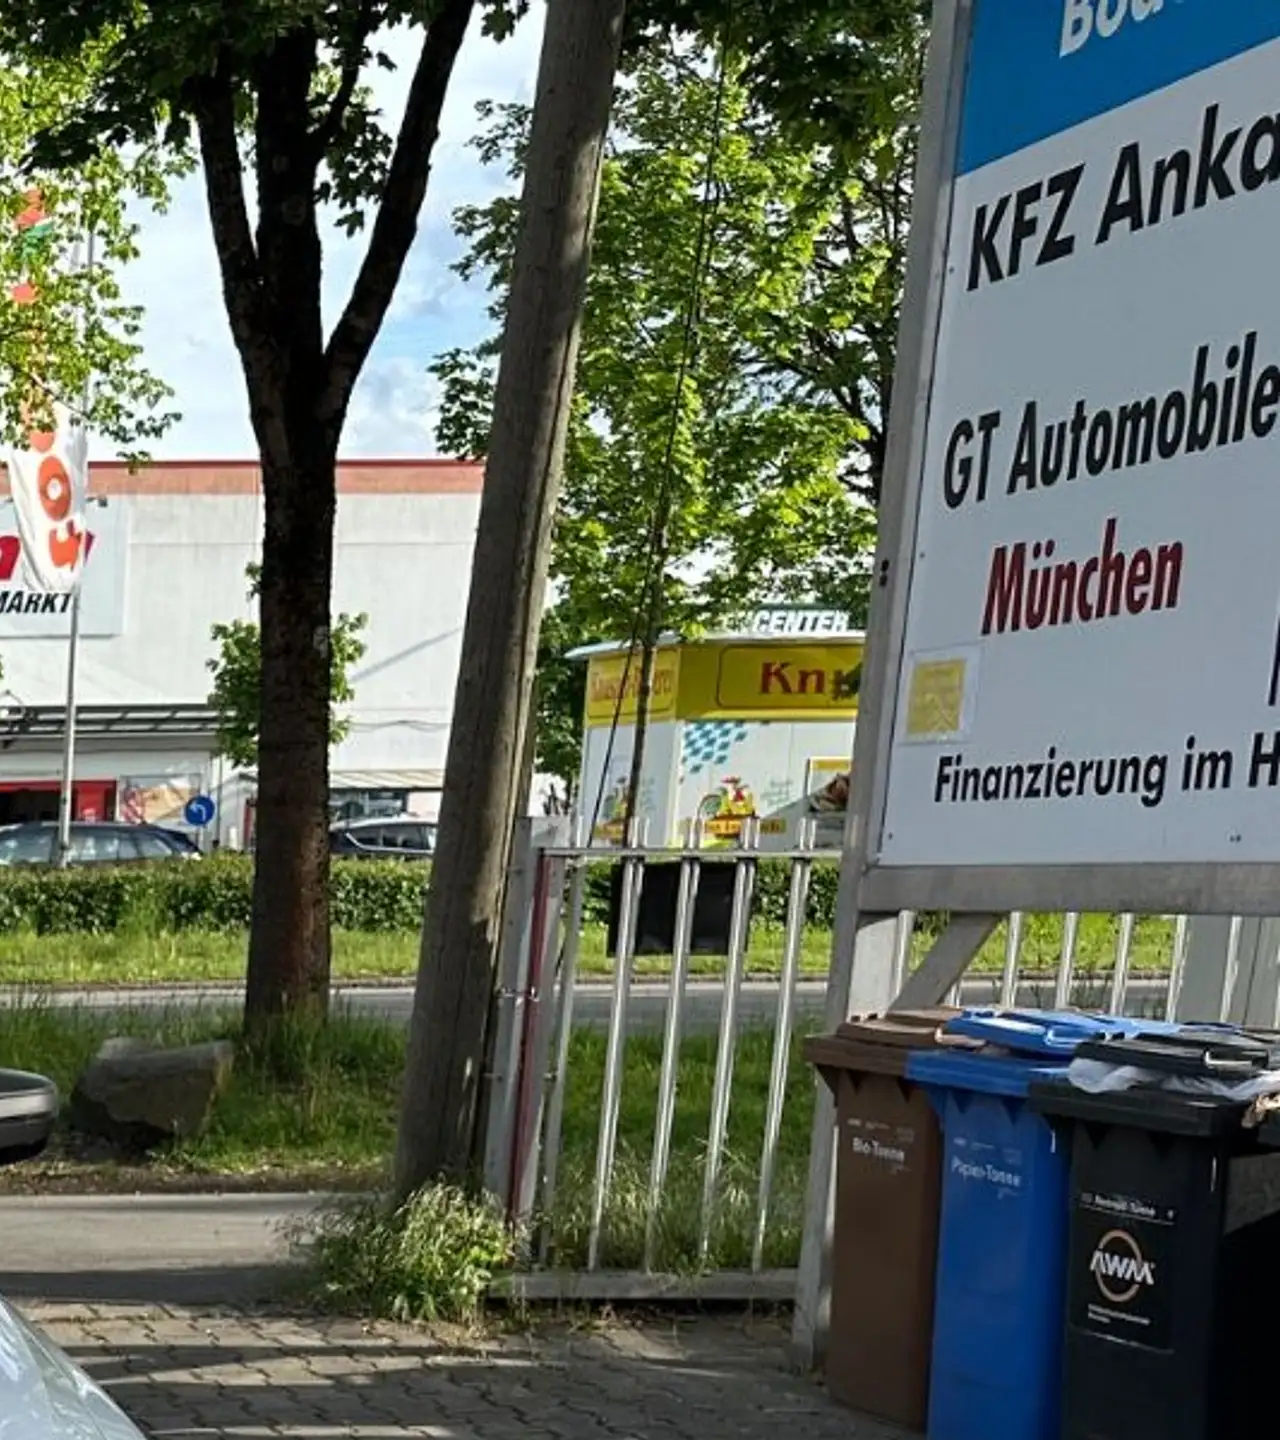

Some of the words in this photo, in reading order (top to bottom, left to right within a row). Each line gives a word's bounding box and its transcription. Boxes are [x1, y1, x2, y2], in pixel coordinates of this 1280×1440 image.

[966, 163, 1086, 292] KFZ
[943, 411, 1001, 509] GT
[1007, 331, 1279, 495] Automobile
[981, 516, 1184, 636] München
[934, 745, 1167, 808] Finanzierung
[1182, 734, 1233, 792] im
[1090, 1250, 1155, 1286] AWM
